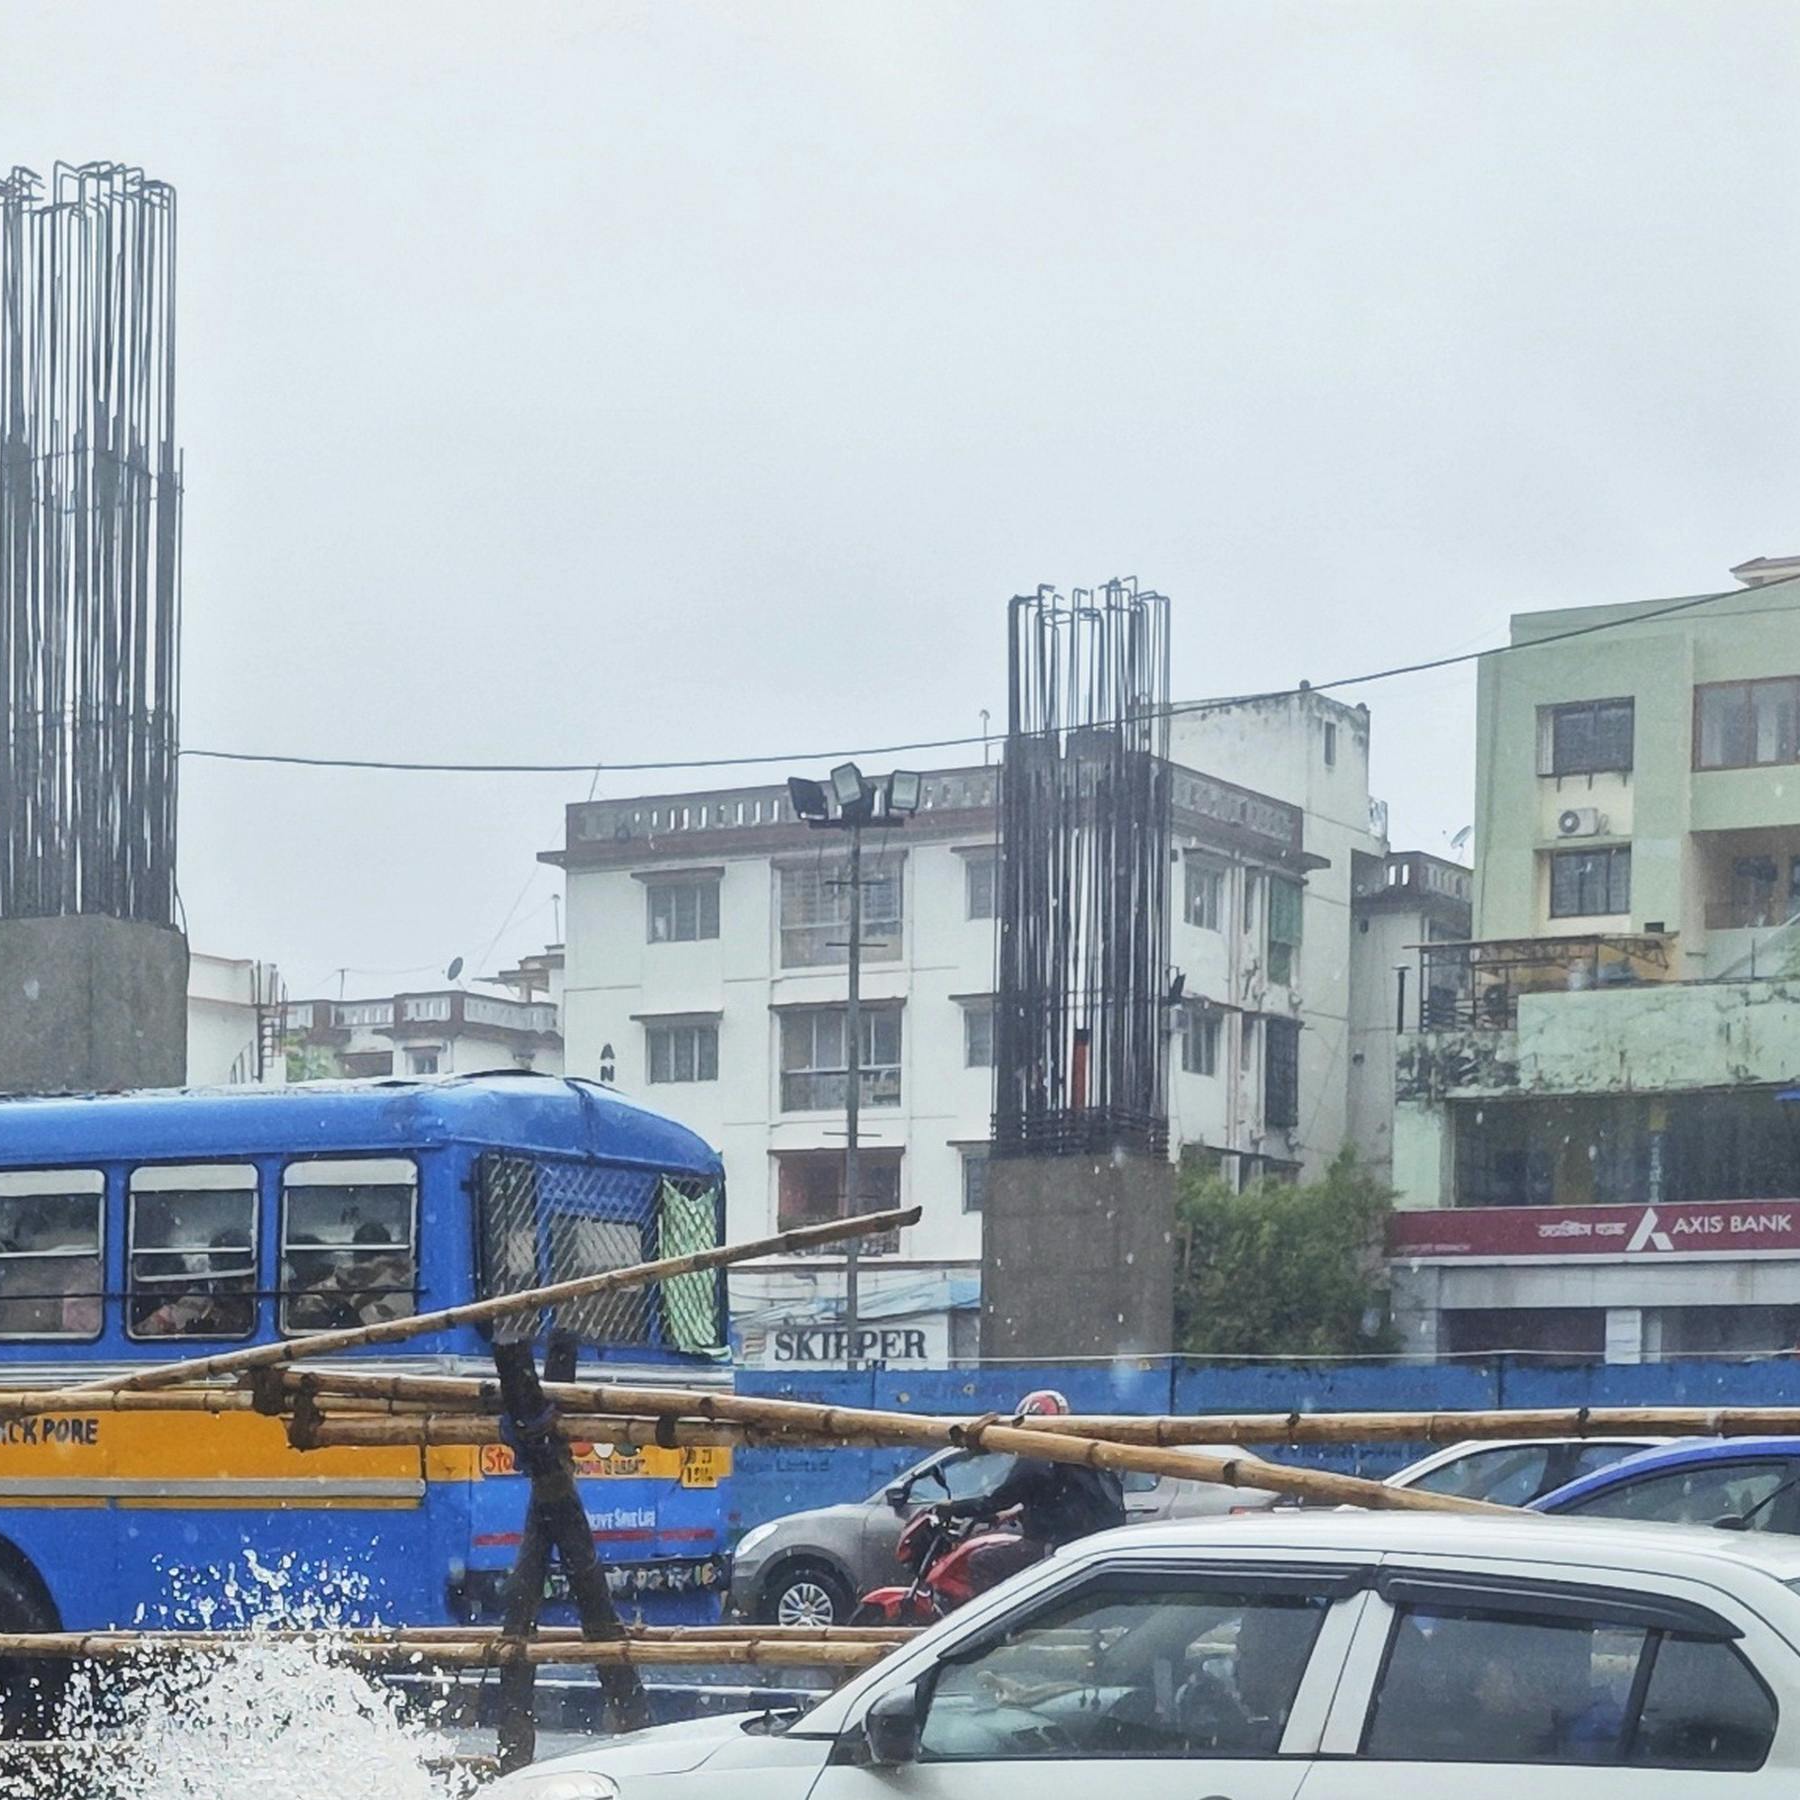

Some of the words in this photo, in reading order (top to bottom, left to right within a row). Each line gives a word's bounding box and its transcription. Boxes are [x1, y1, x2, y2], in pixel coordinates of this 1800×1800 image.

[1671, 1216, 1724, 1234] AXIS
[1730, 1213, 1792, 1233] BANK
[774, 1328, 927, 1362] SKIPPER
